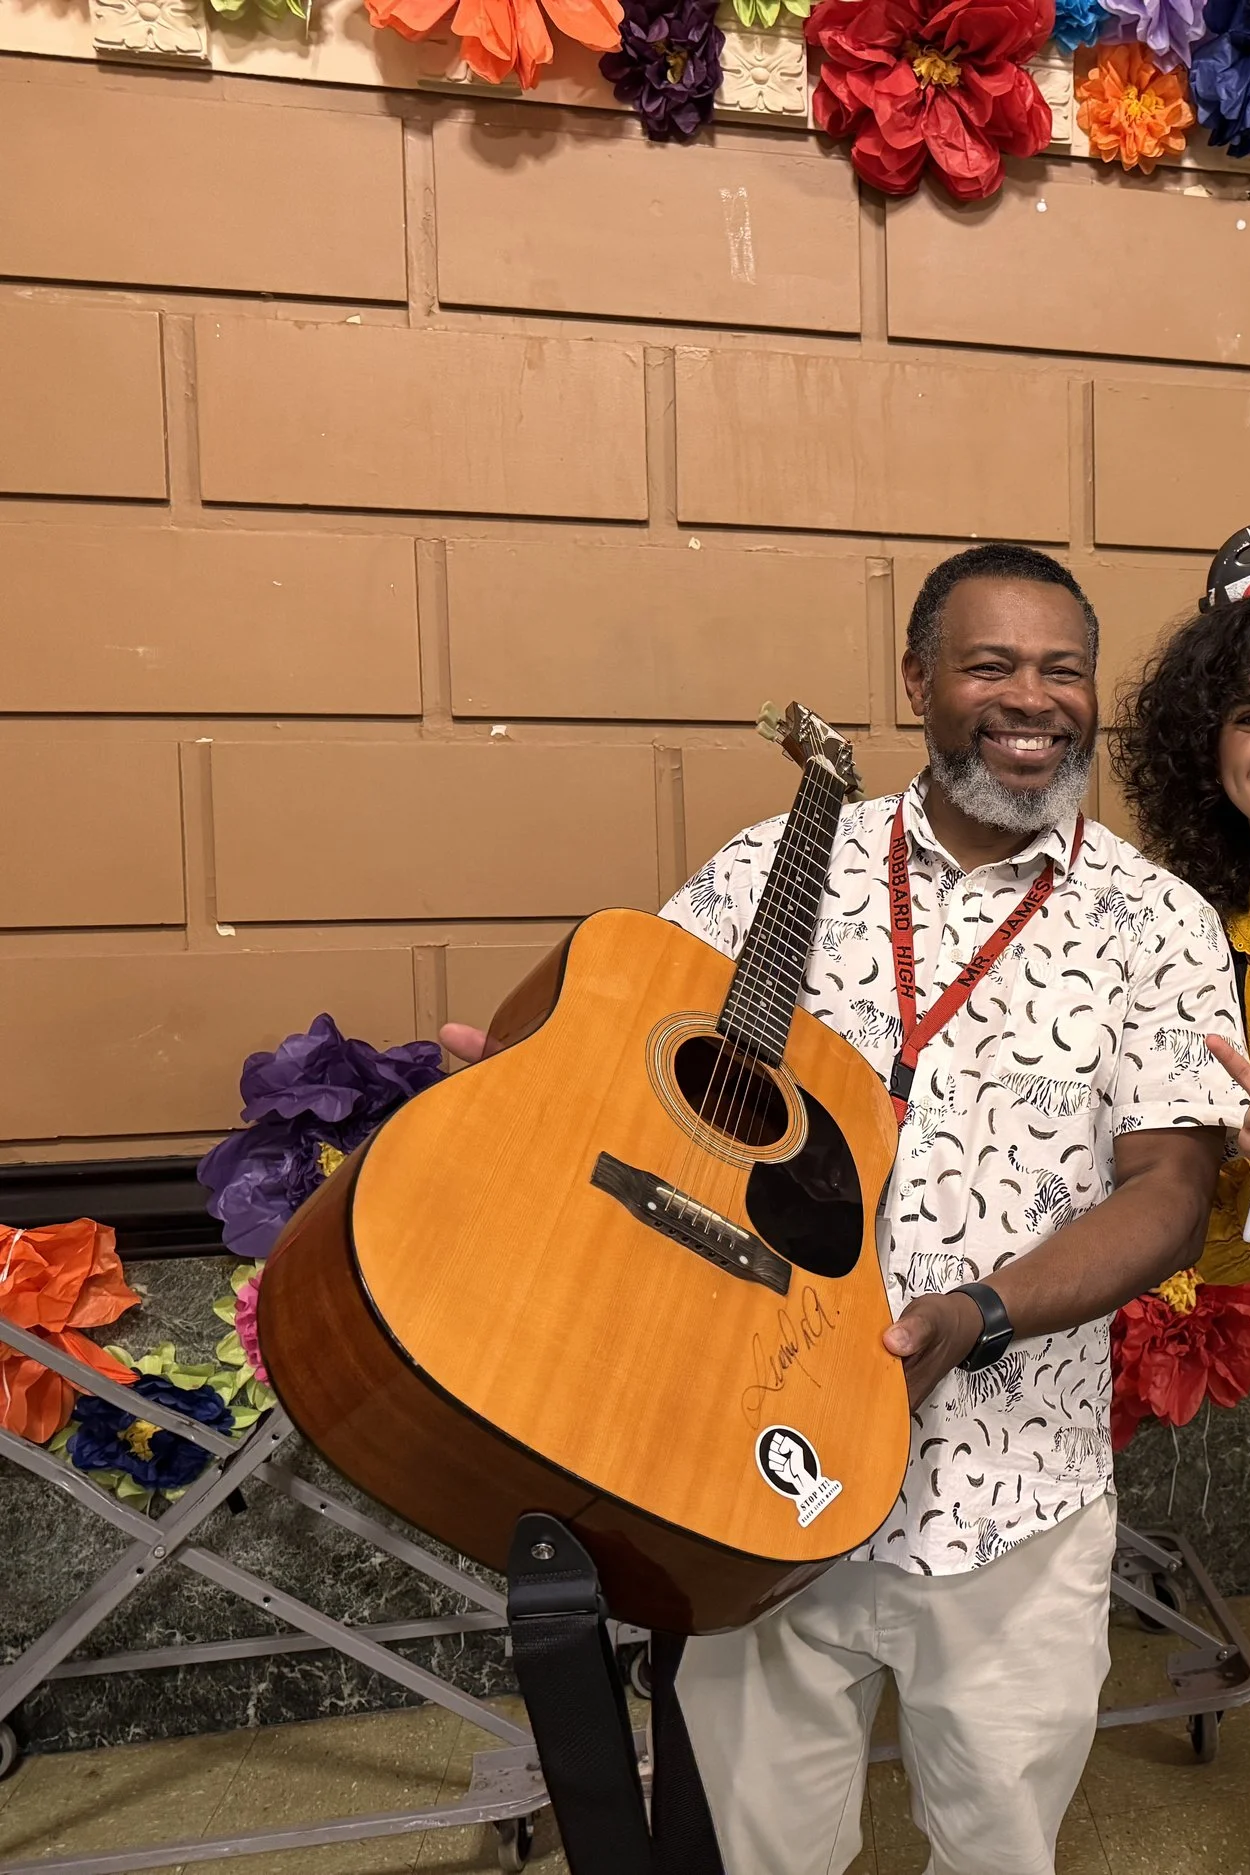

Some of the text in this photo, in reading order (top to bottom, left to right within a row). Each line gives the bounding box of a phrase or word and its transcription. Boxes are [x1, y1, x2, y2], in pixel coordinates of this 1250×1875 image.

[891, 835, 916, 1000] HUBBARD HIGH
[957, 877, 1052, 989] MR. JAMES
[800, 1480, 830, 1511] STOP IT!
